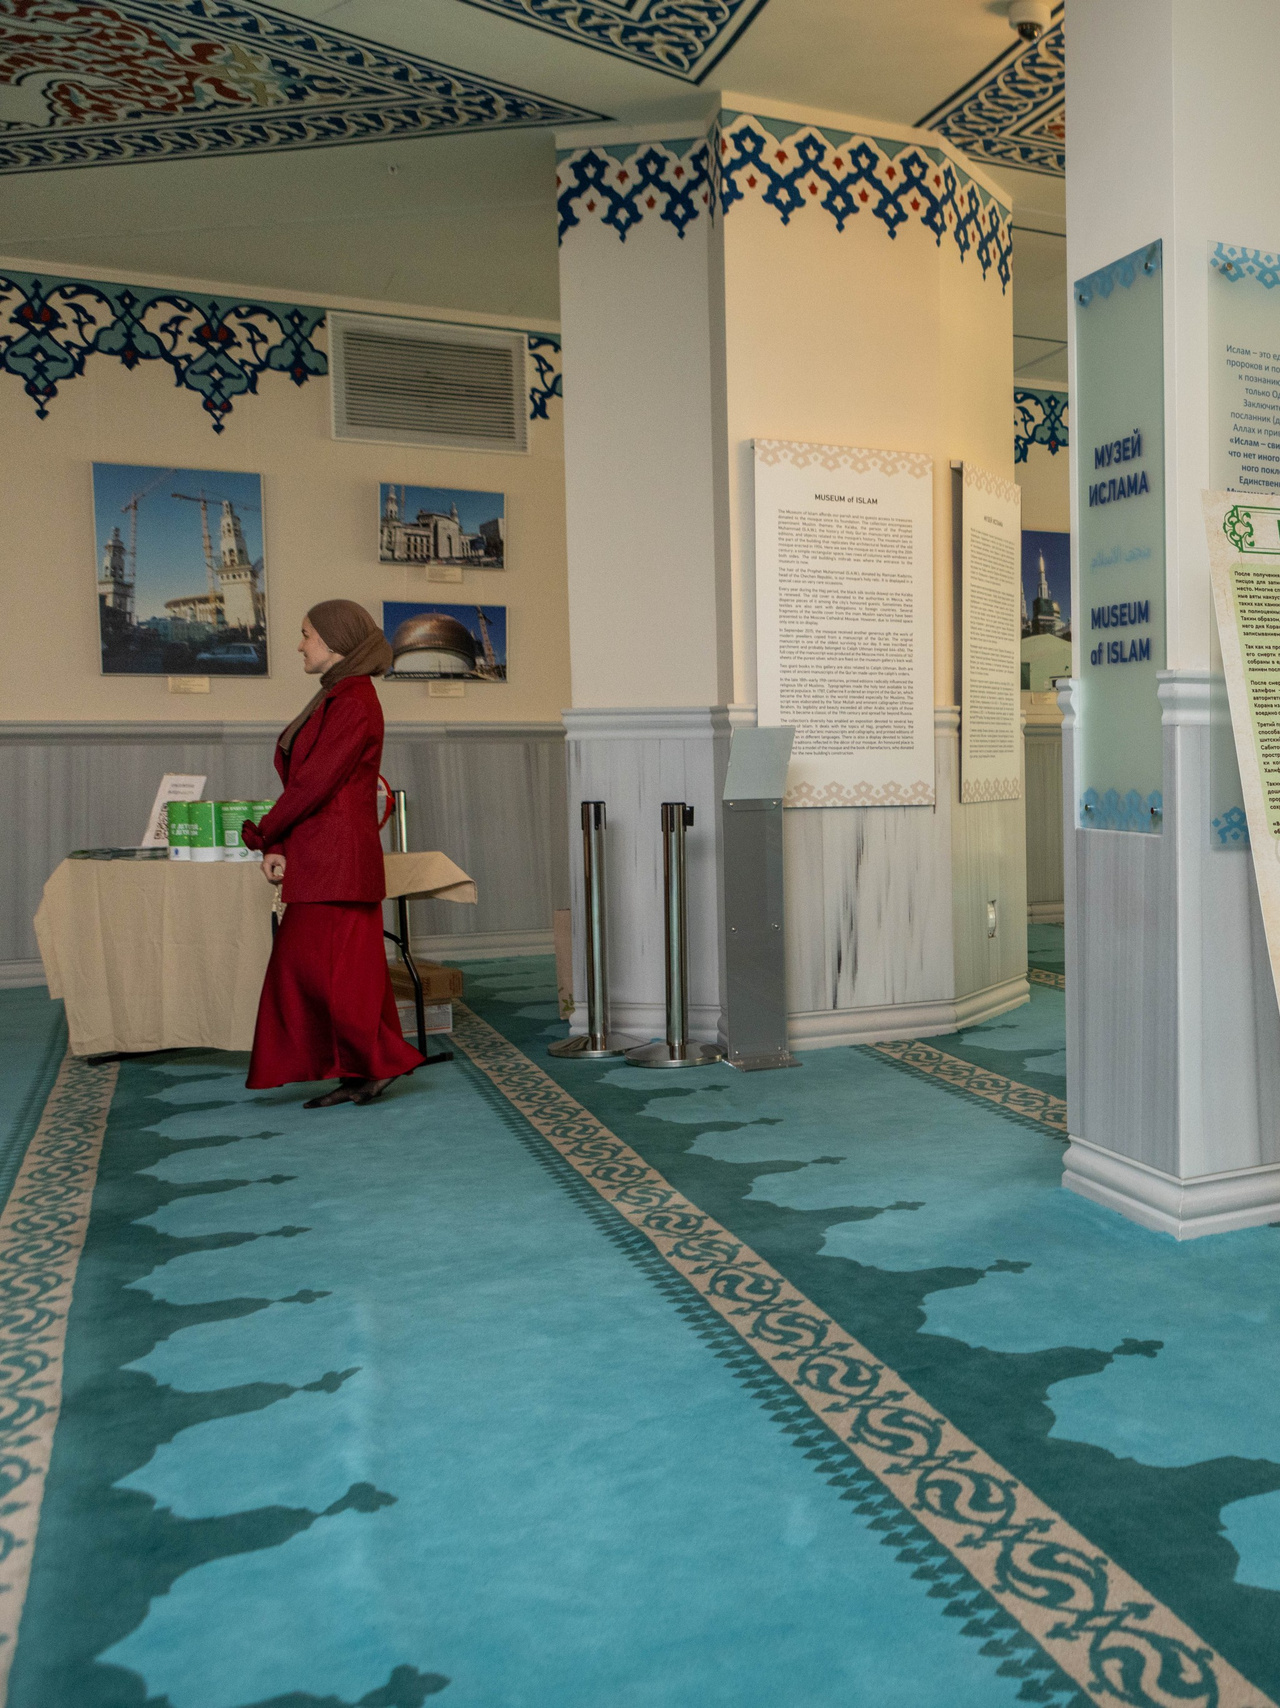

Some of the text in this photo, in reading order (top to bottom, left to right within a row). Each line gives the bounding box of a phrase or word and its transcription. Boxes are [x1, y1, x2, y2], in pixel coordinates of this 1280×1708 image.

[1227, 345, 1250, 355] Ислам
[1227, 359, 1262, 370] пророков
[1246, 388, 1270, 397] только
[1231, 412, 1271, 422] посланник
[1233, 424, 1255, 434] Аллах
[1230, 437, 1259, 447] «Ислам
[1095, 428, 1142, 469] МУЗЕЙ
[1090, 471, 1149, 507] ИСЛАМА
[815, 494, 845, 502] MUSEUM
[1092, 600, 1148, 629] MUSEUM
[1091, 638, 1150, 665] of ISLAM
